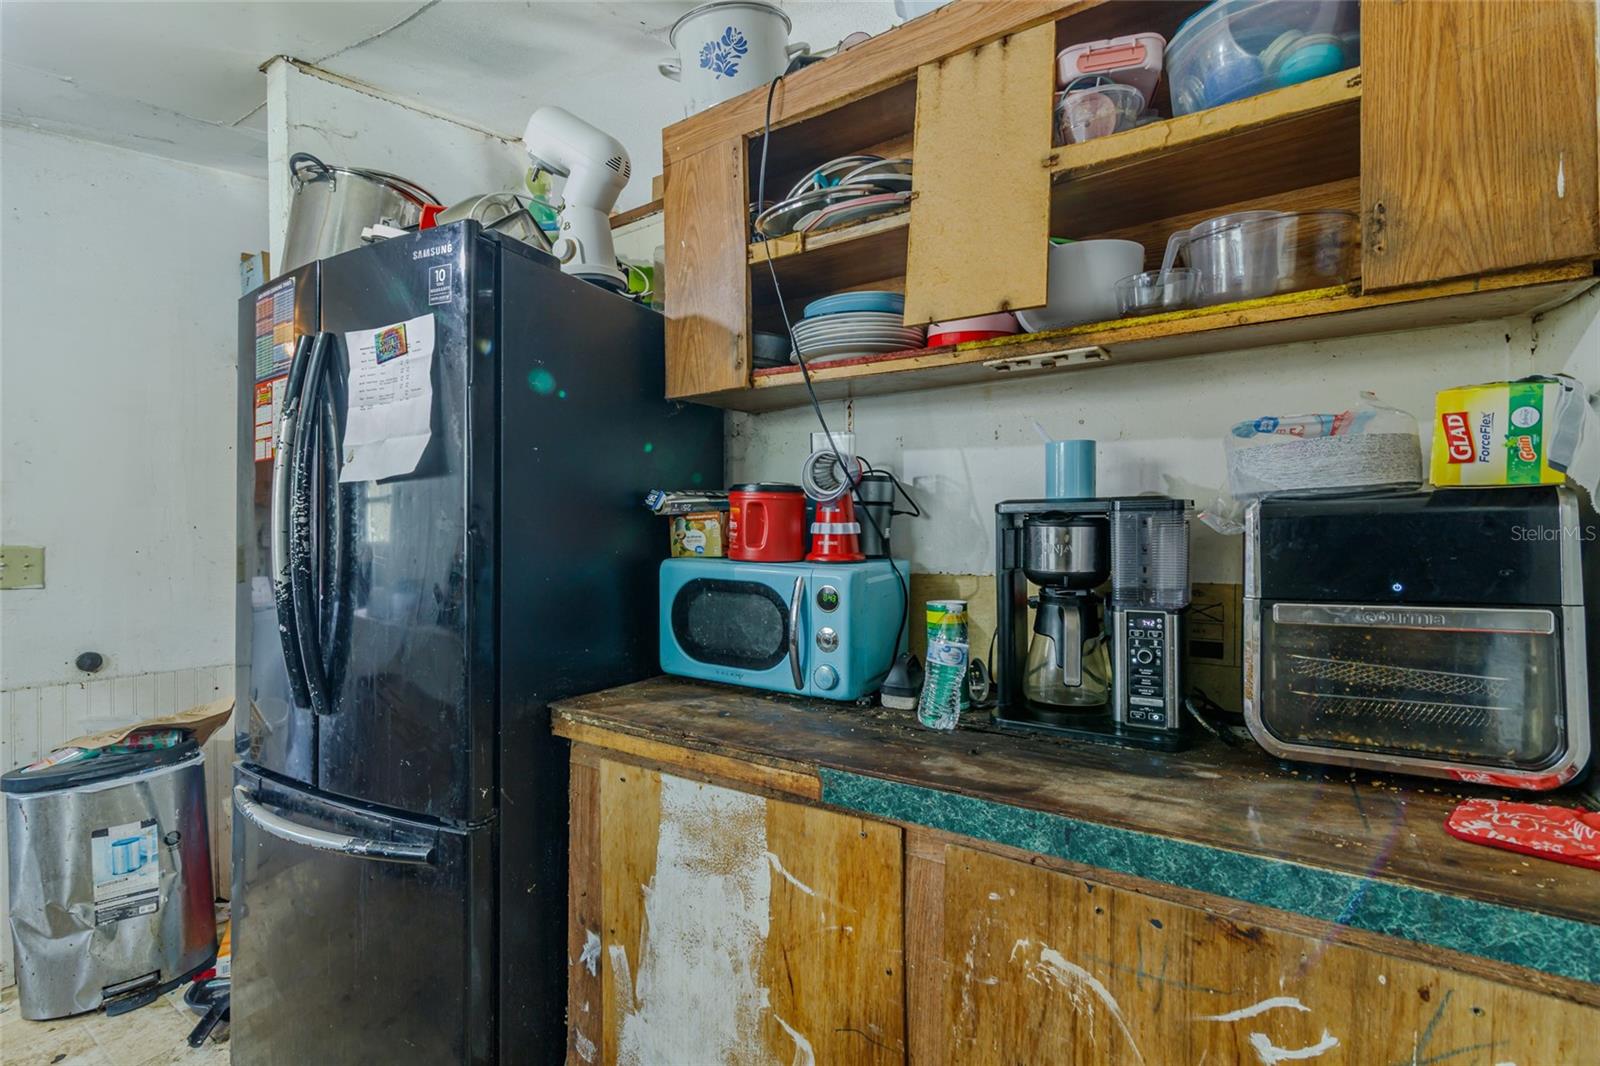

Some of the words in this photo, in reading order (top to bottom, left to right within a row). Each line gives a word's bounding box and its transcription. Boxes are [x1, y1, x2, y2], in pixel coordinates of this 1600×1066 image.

[413, 243, 453, 260] SAMSUNG
[434, 268, 446, 282] 10
[1447, 414, 1473, 461] GLAD
[1479, 411, 1492, 463] ForceFlex
[1518, 436, 1537, 462] Gain
